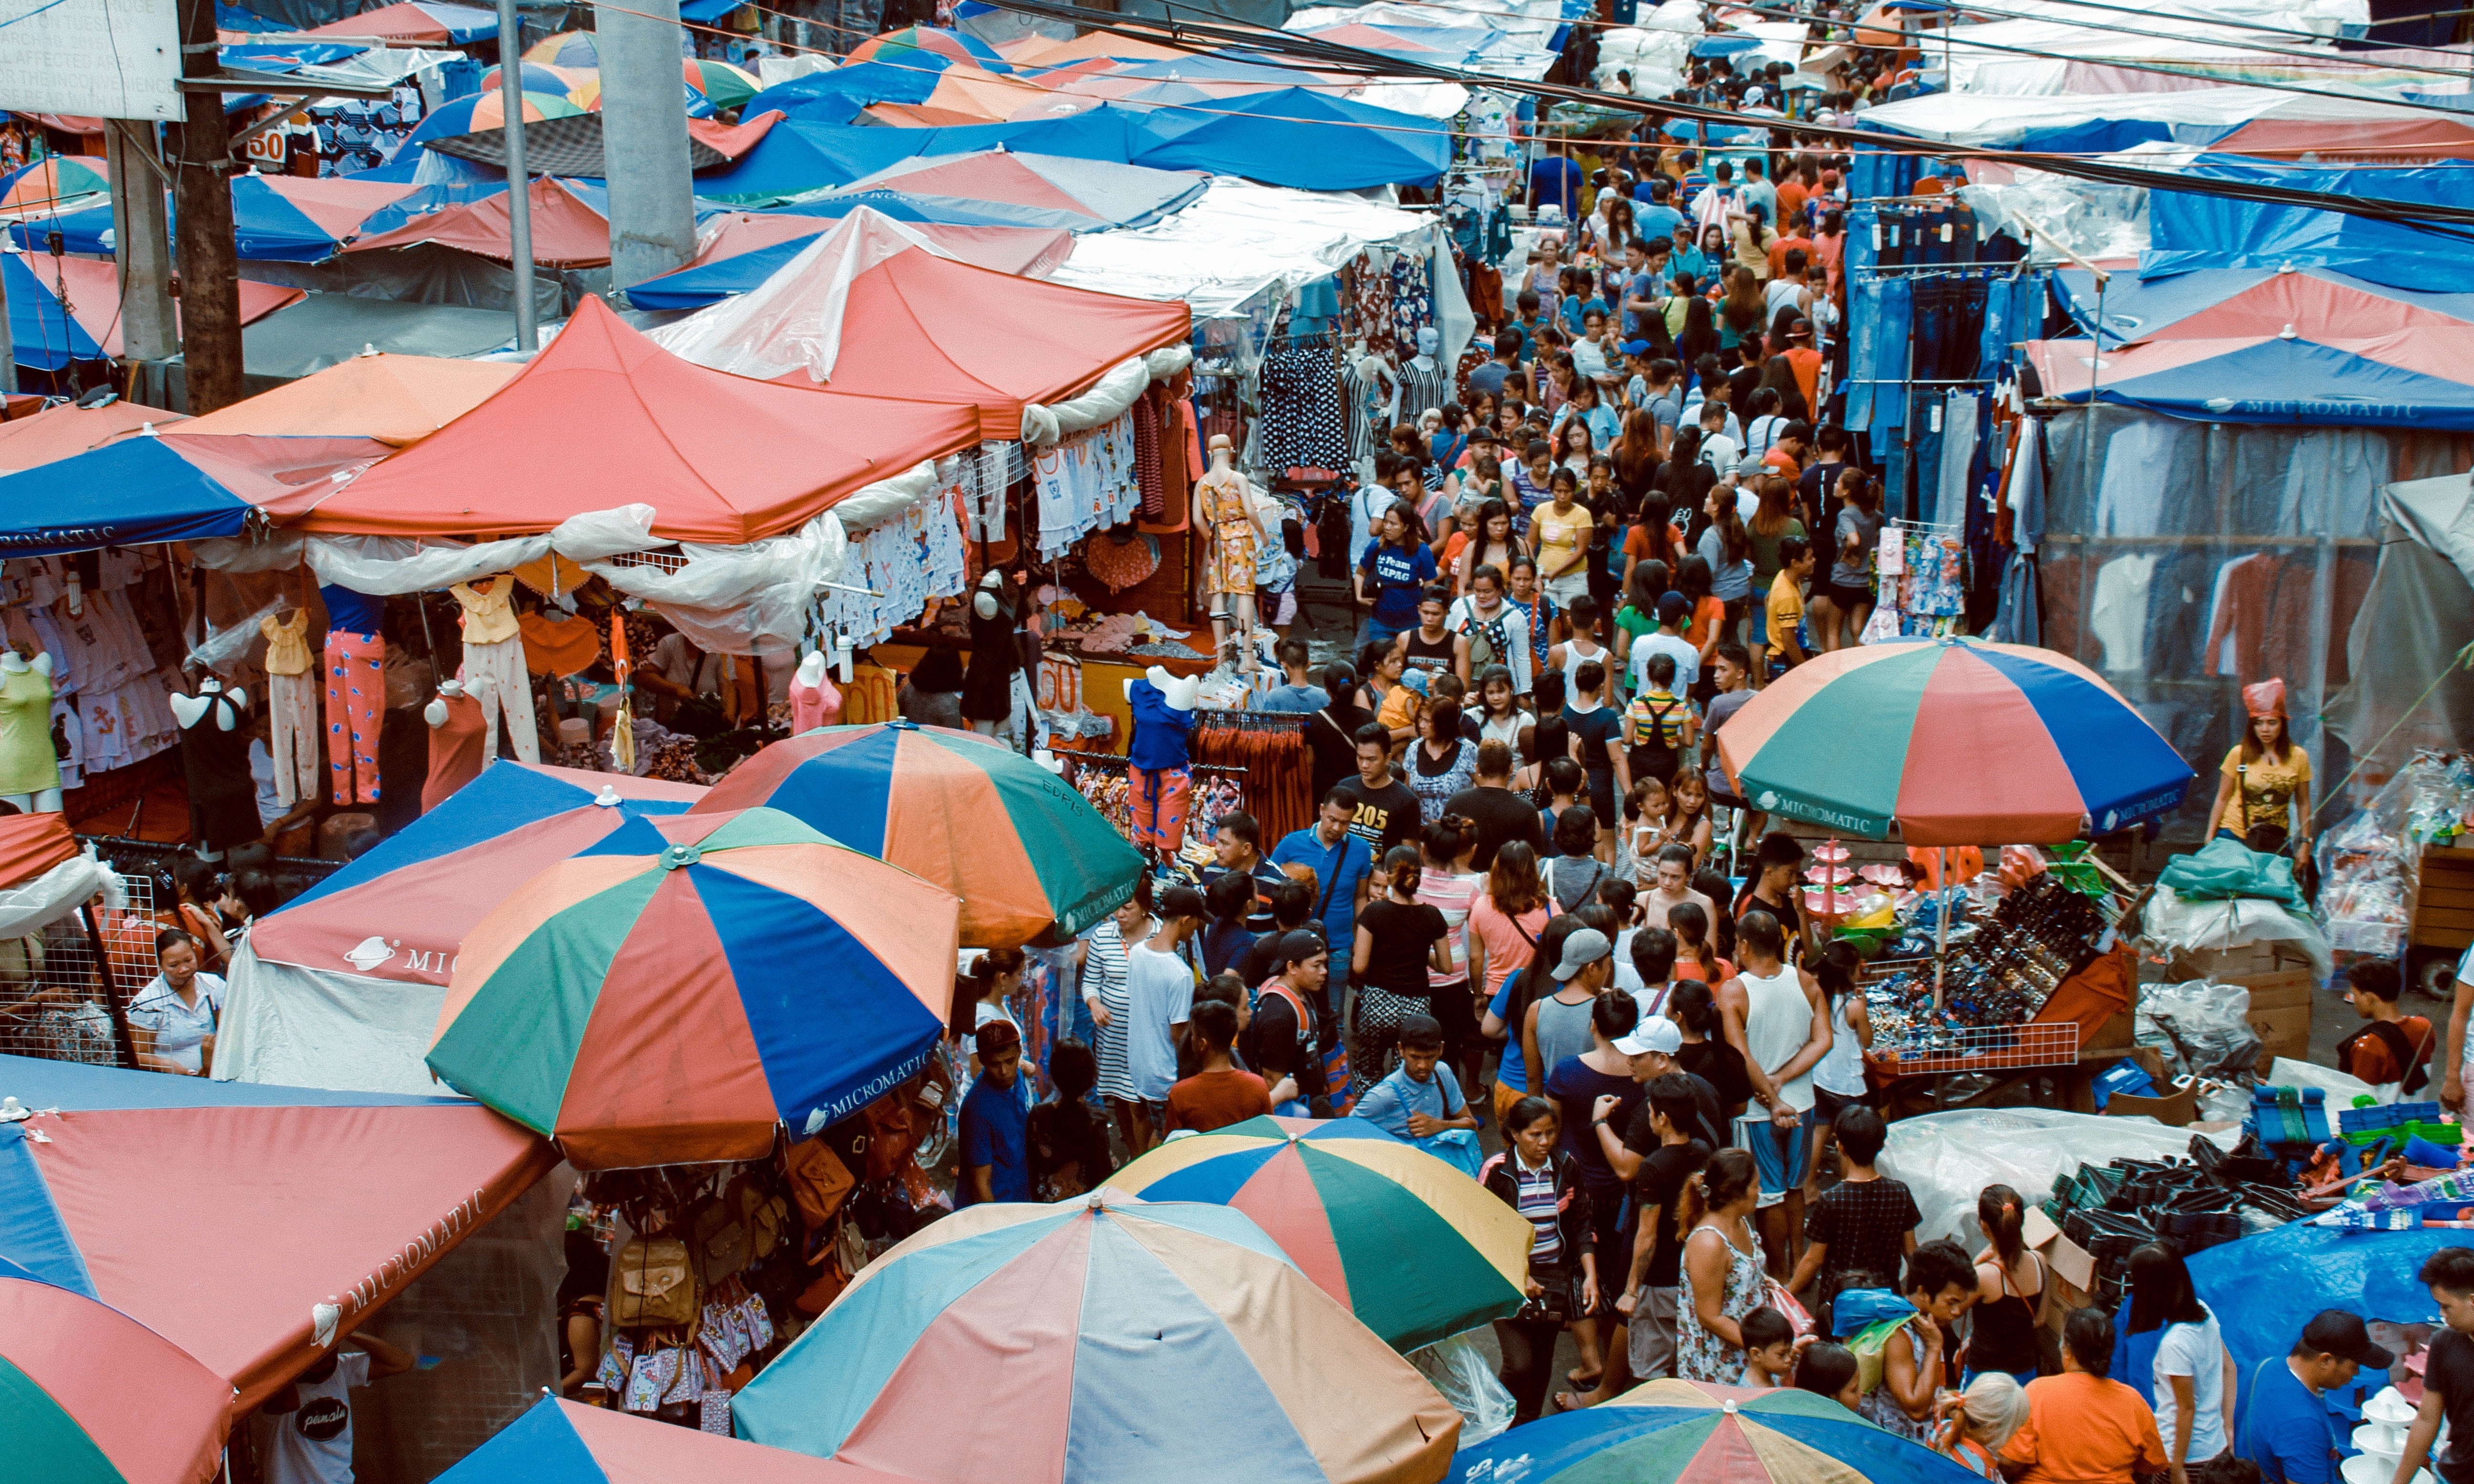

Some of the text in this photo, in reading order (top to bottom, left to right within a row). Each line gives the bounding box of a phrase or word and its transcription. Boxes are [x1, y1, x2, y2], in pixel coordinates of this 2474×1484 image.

[2244, 401, 2421, 419] MICROMATIC
[1352, 802, 1388, 830] 205
[1781, 798, 1870, 832] MICROMATIC
[830, 1049, 931, 1118] MICROMATIC
[347, 1188, 484, 1316] MICROMATIC
